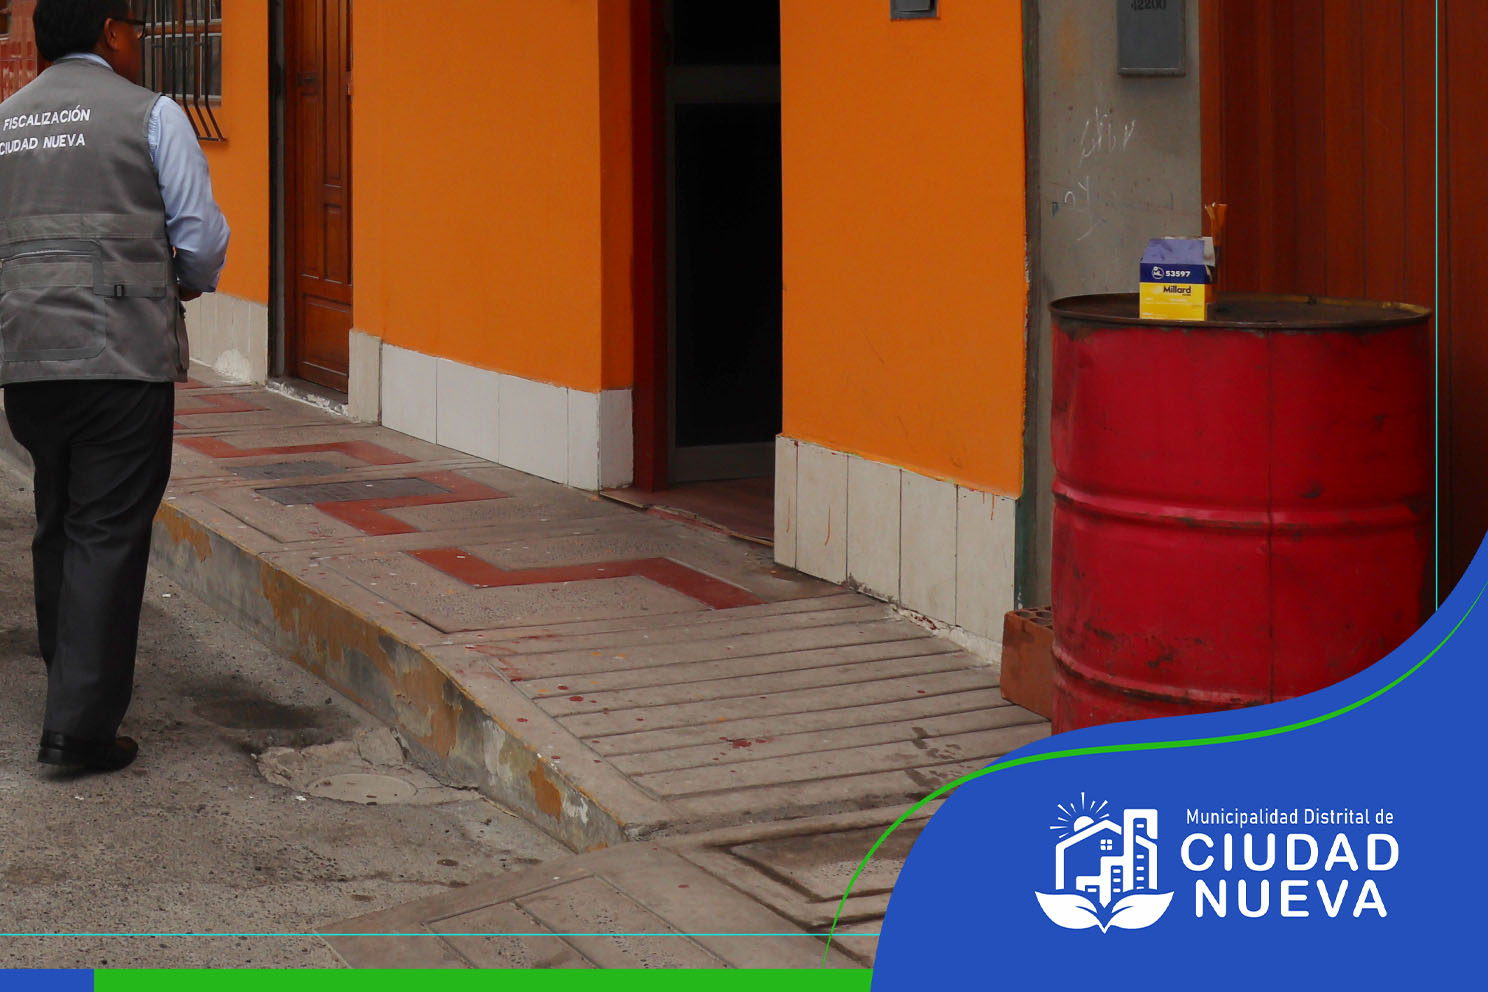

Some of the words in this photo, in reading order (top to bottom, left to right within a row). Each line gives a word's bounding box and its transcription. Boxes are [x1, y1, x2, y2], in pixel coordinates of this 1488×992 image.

[3, 105, 91, 131] FISCALIZACIÓN
[42, 133, 86, 149] NUEVA
[1163, 285, 1192, 294] Millard
